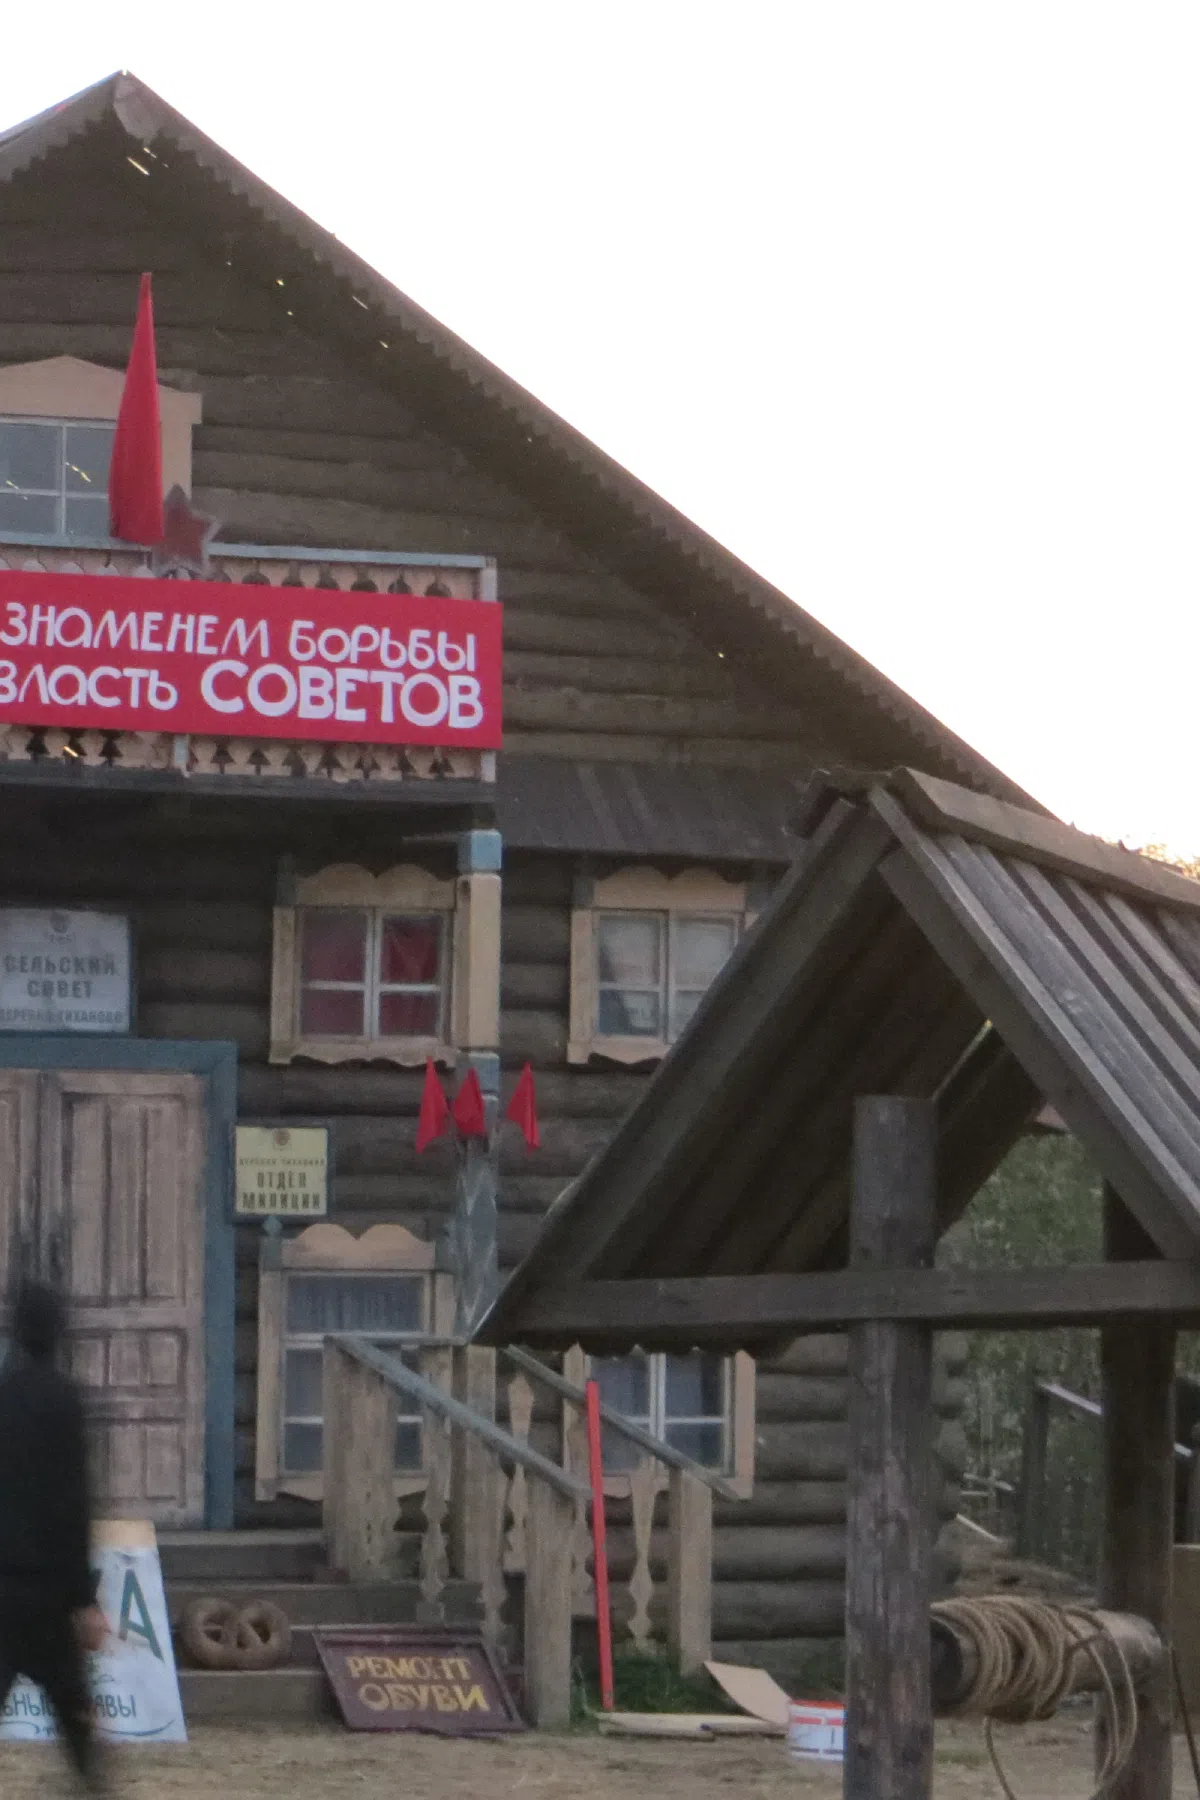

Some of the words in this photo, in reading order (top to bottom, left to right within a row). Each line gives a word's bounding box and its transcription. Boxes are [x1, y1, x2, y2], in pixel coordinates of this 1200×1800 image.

[201, 660, 483, 728] СОВЕТОВ
[4, 952, 116, 976] СЕЛЬСКИЙ
[27, 979, 92, 999] СОВЕТ
[359, 1684, 490, 1712] ОБУВИ
